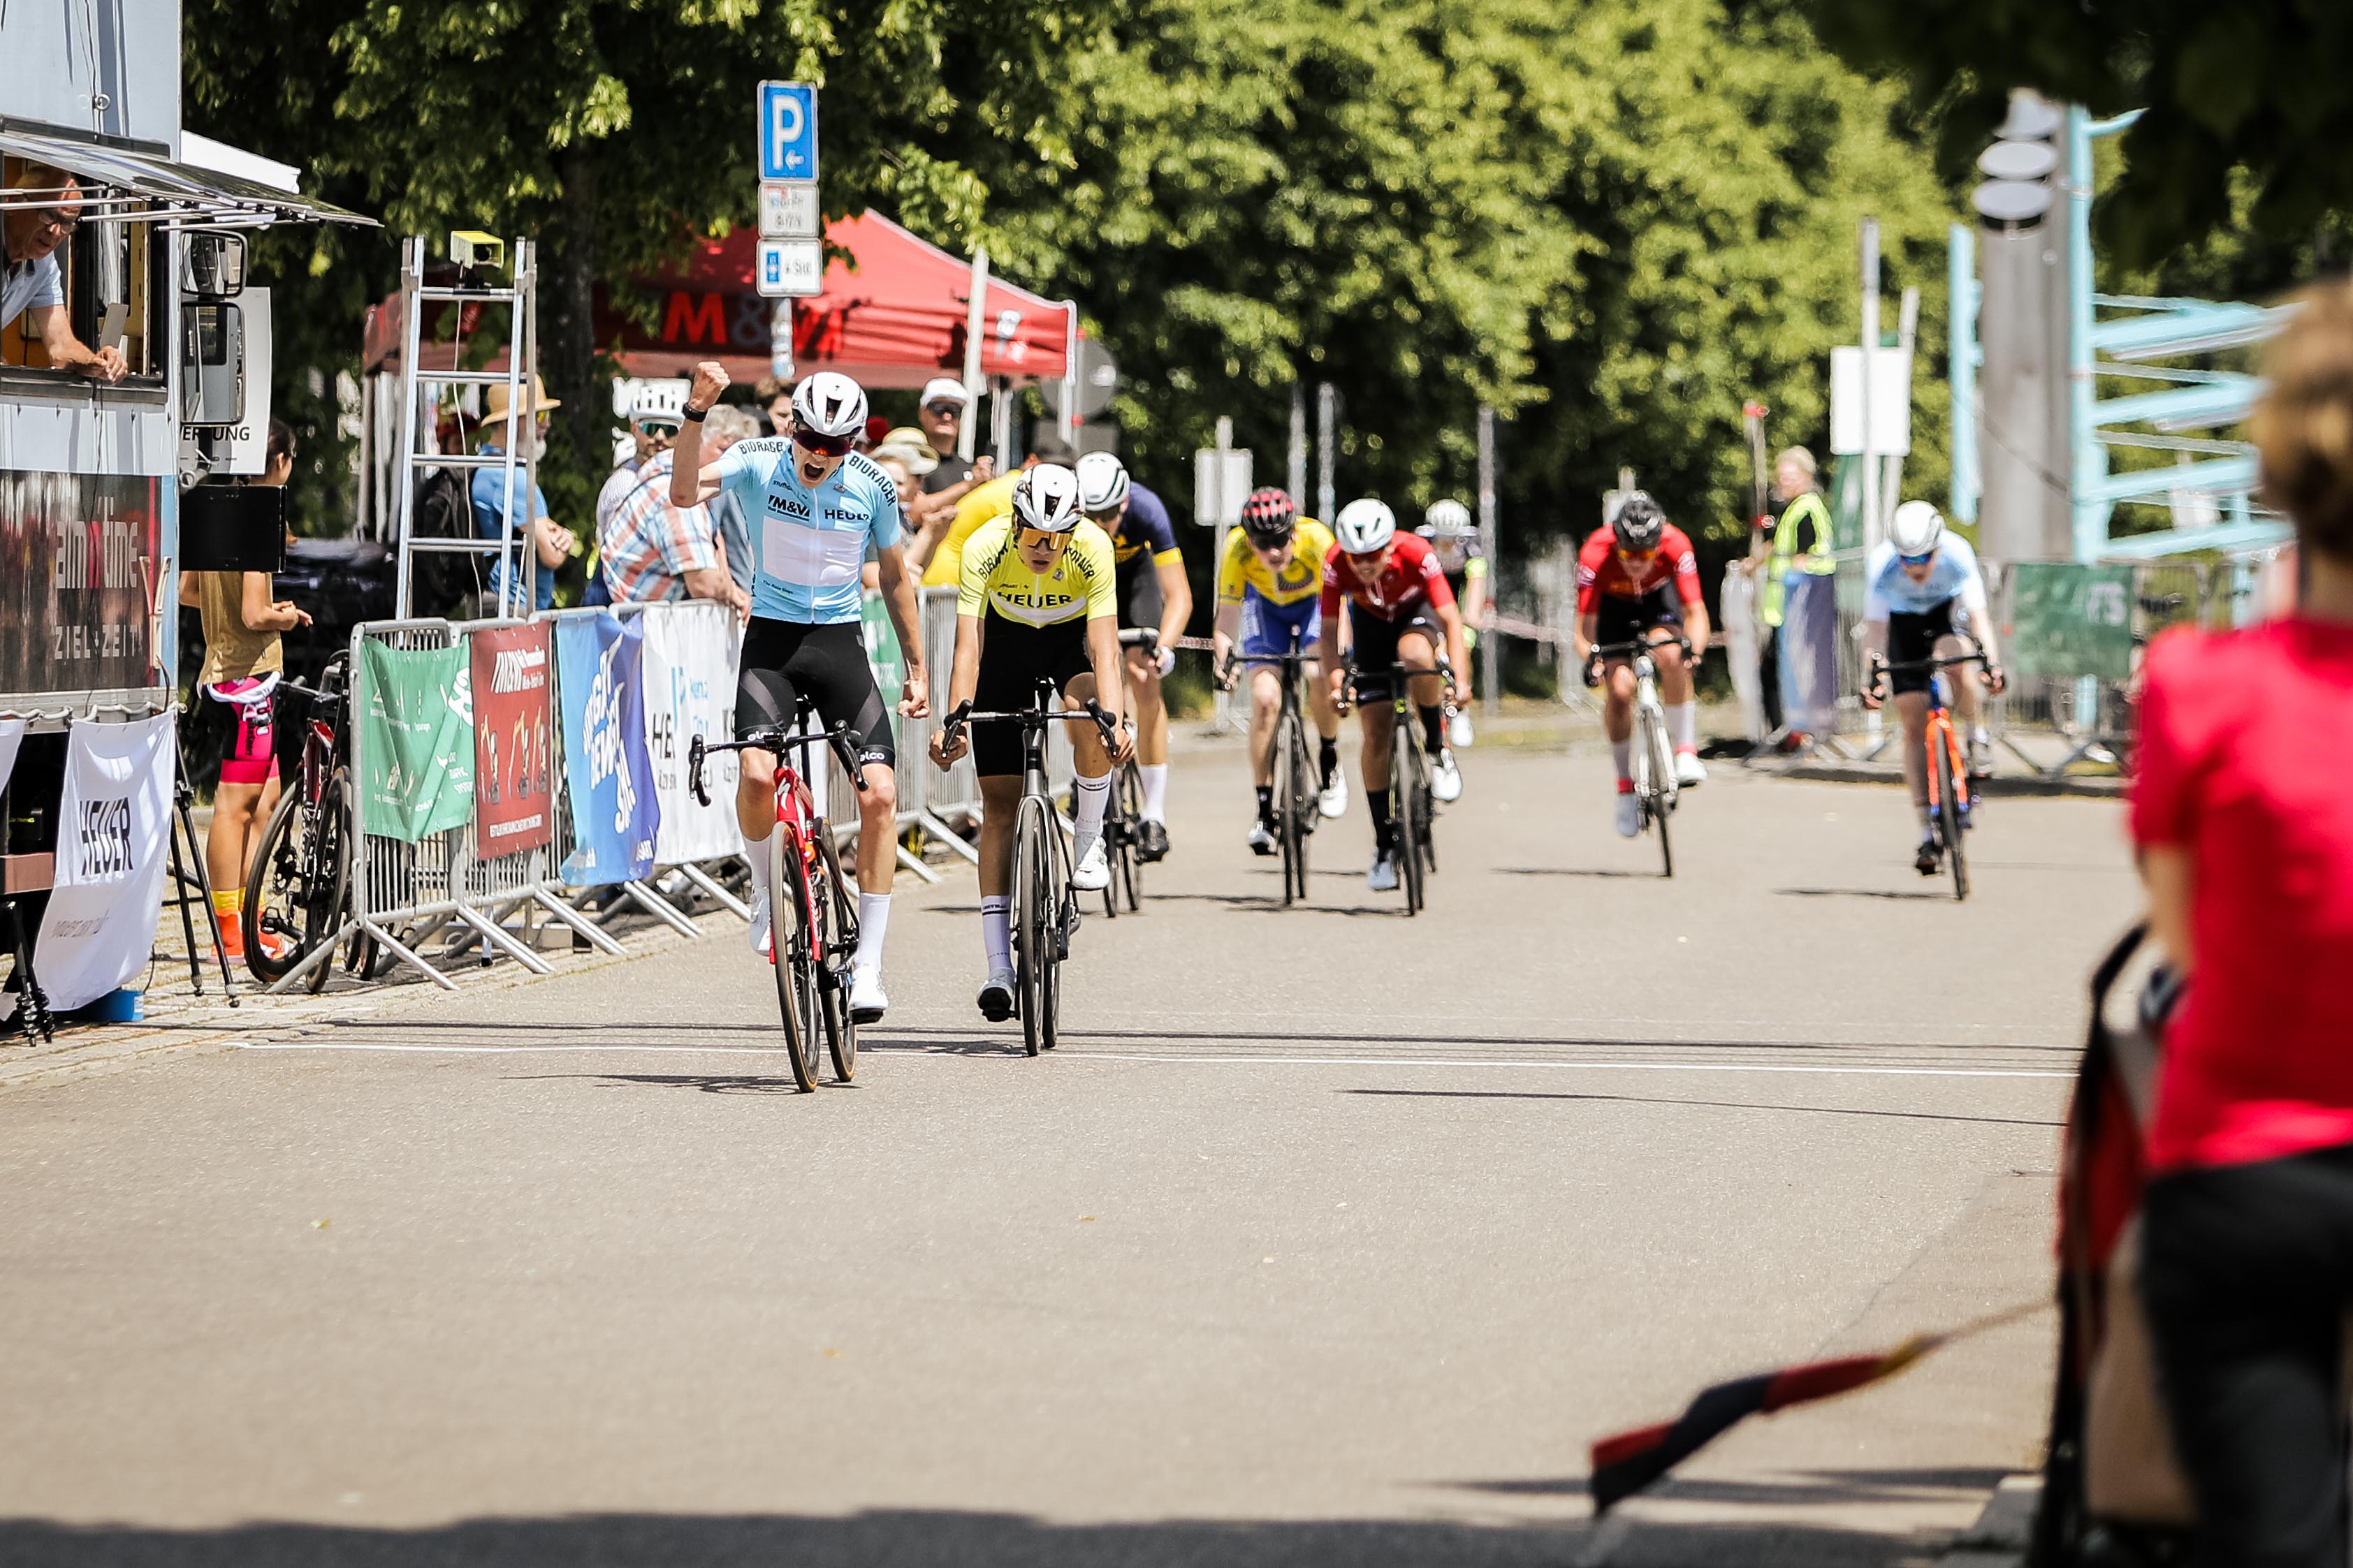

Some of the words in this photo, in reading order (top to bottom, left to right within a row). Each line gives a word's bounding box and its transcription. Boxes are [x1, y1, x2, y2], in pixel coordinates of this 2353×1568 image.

[772, 94, 804, 170] P
[848, 455, 896, 506] BIORACER
[997, 592, 1072, 608] HEUER
[80, 796, 133, 877] HEUER
